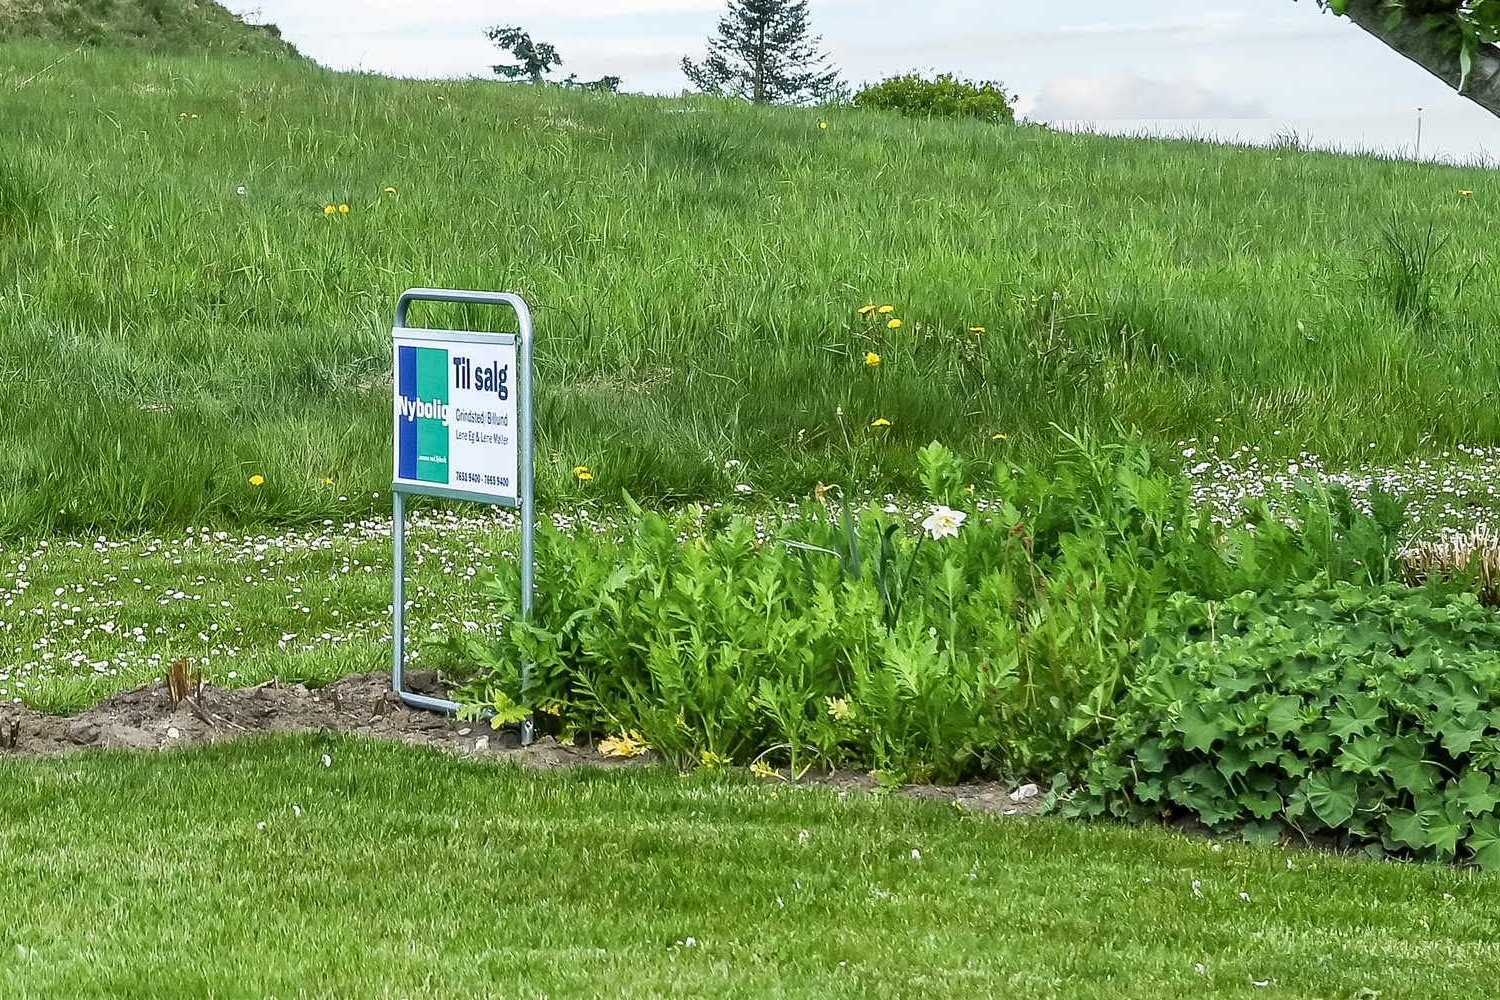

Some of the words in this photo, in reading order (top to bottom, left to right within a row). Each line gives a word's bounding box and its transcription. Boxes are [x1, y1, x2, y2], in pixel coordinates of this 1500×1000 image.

[453, 356, 471, 389] Til
[474, 360, 508, 400] salg
[399, 395, 449, 426] Nybolig
